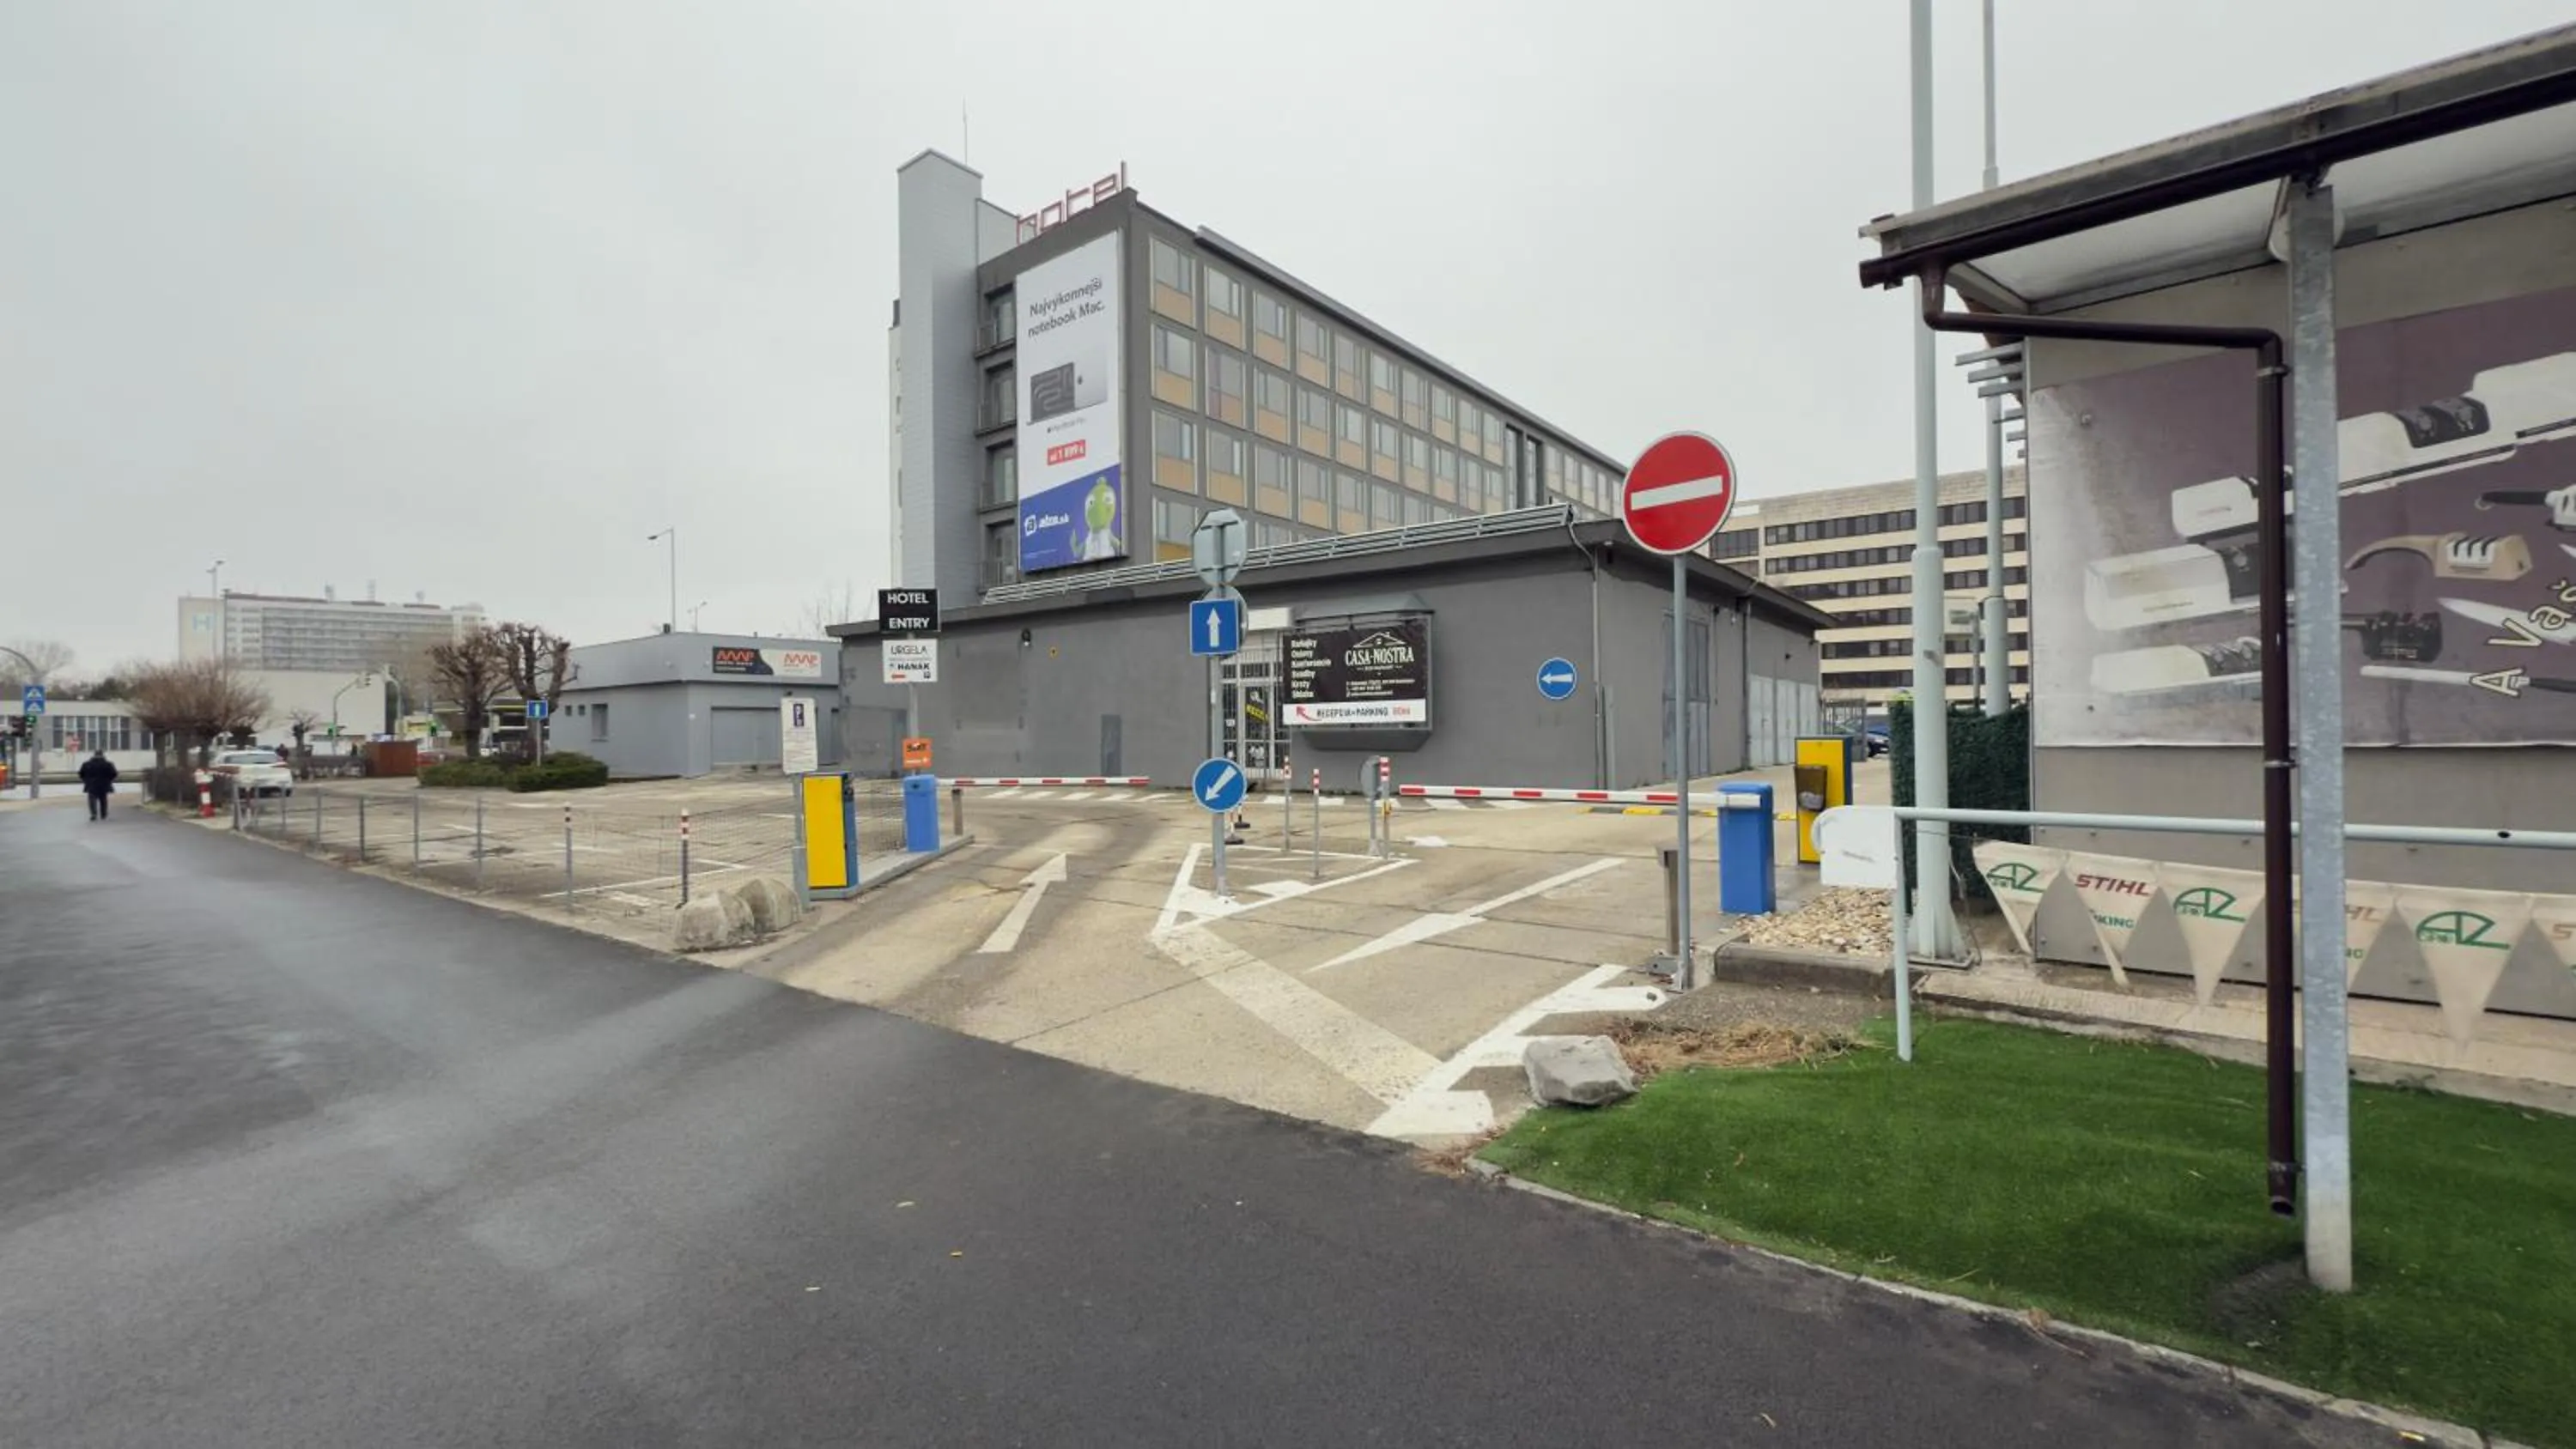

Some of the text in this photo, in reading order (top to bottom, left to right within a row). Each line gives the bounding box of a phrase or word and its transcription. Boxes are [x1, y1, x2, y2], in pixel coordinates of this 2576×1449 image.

[1028, 300, 1105, 338] notebook Mac.
[887, 592, 930, 604] HOTEL
[889, 617, 930, 629] ENTRY
[2075, 874, 2152, 897] STIHL
